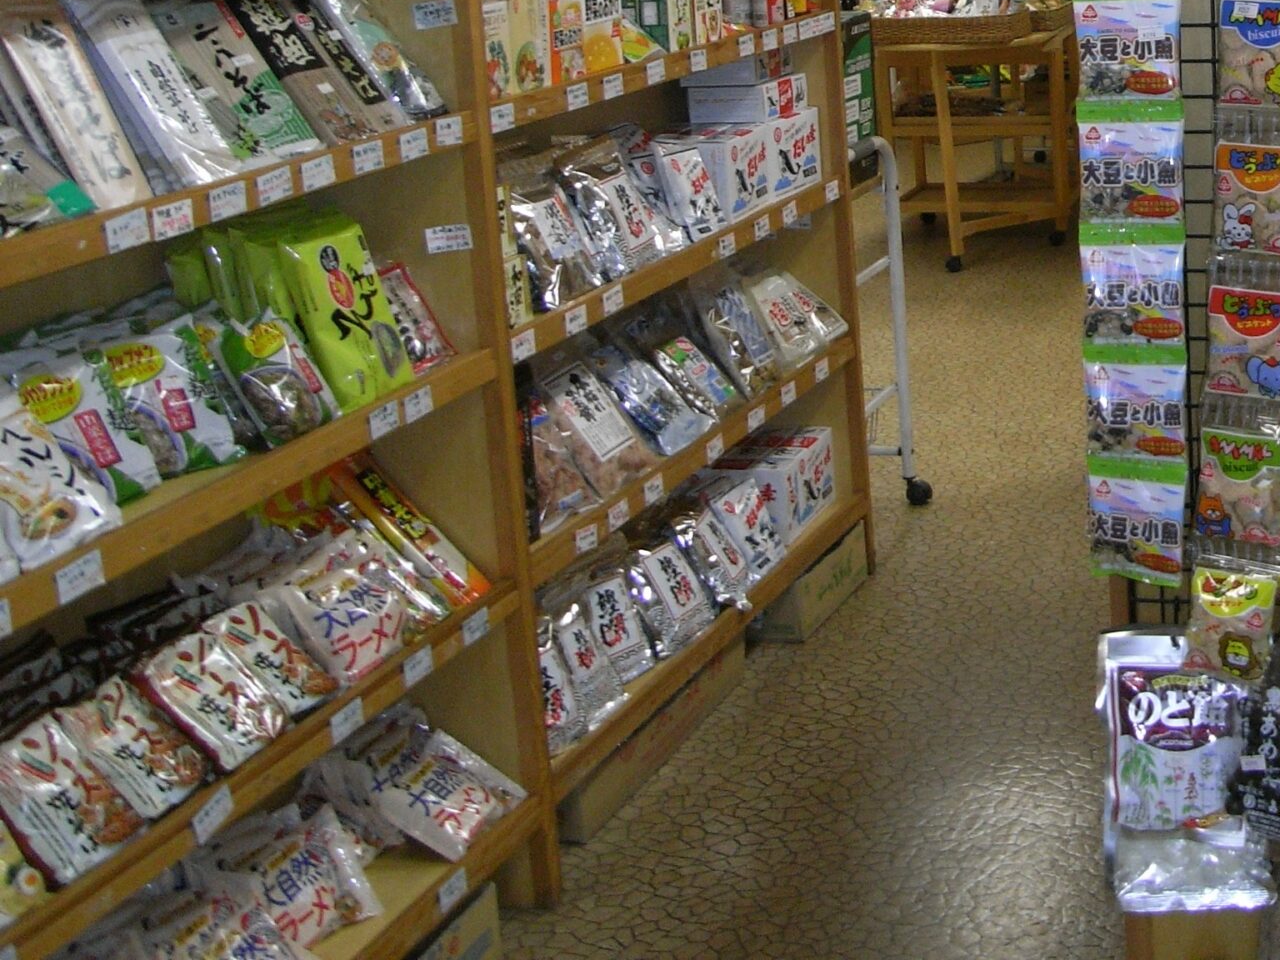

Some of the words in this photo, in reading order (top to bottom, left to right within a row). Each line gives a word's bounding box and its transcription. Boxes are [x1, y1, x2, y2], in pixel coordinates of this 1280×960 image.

[1079, 36, 1175, 63] 大豆と小魚
[1081, 158, 1179, 186] 大豆と小魚
[1087, 281, 1180, 309] 大豆と小魚
[1088, 399, 1182, 427] 大豆と小魚
[1091, 514, 1180, 546] 大豆と小魚
[330, 609, 405, 672] ラーメン
